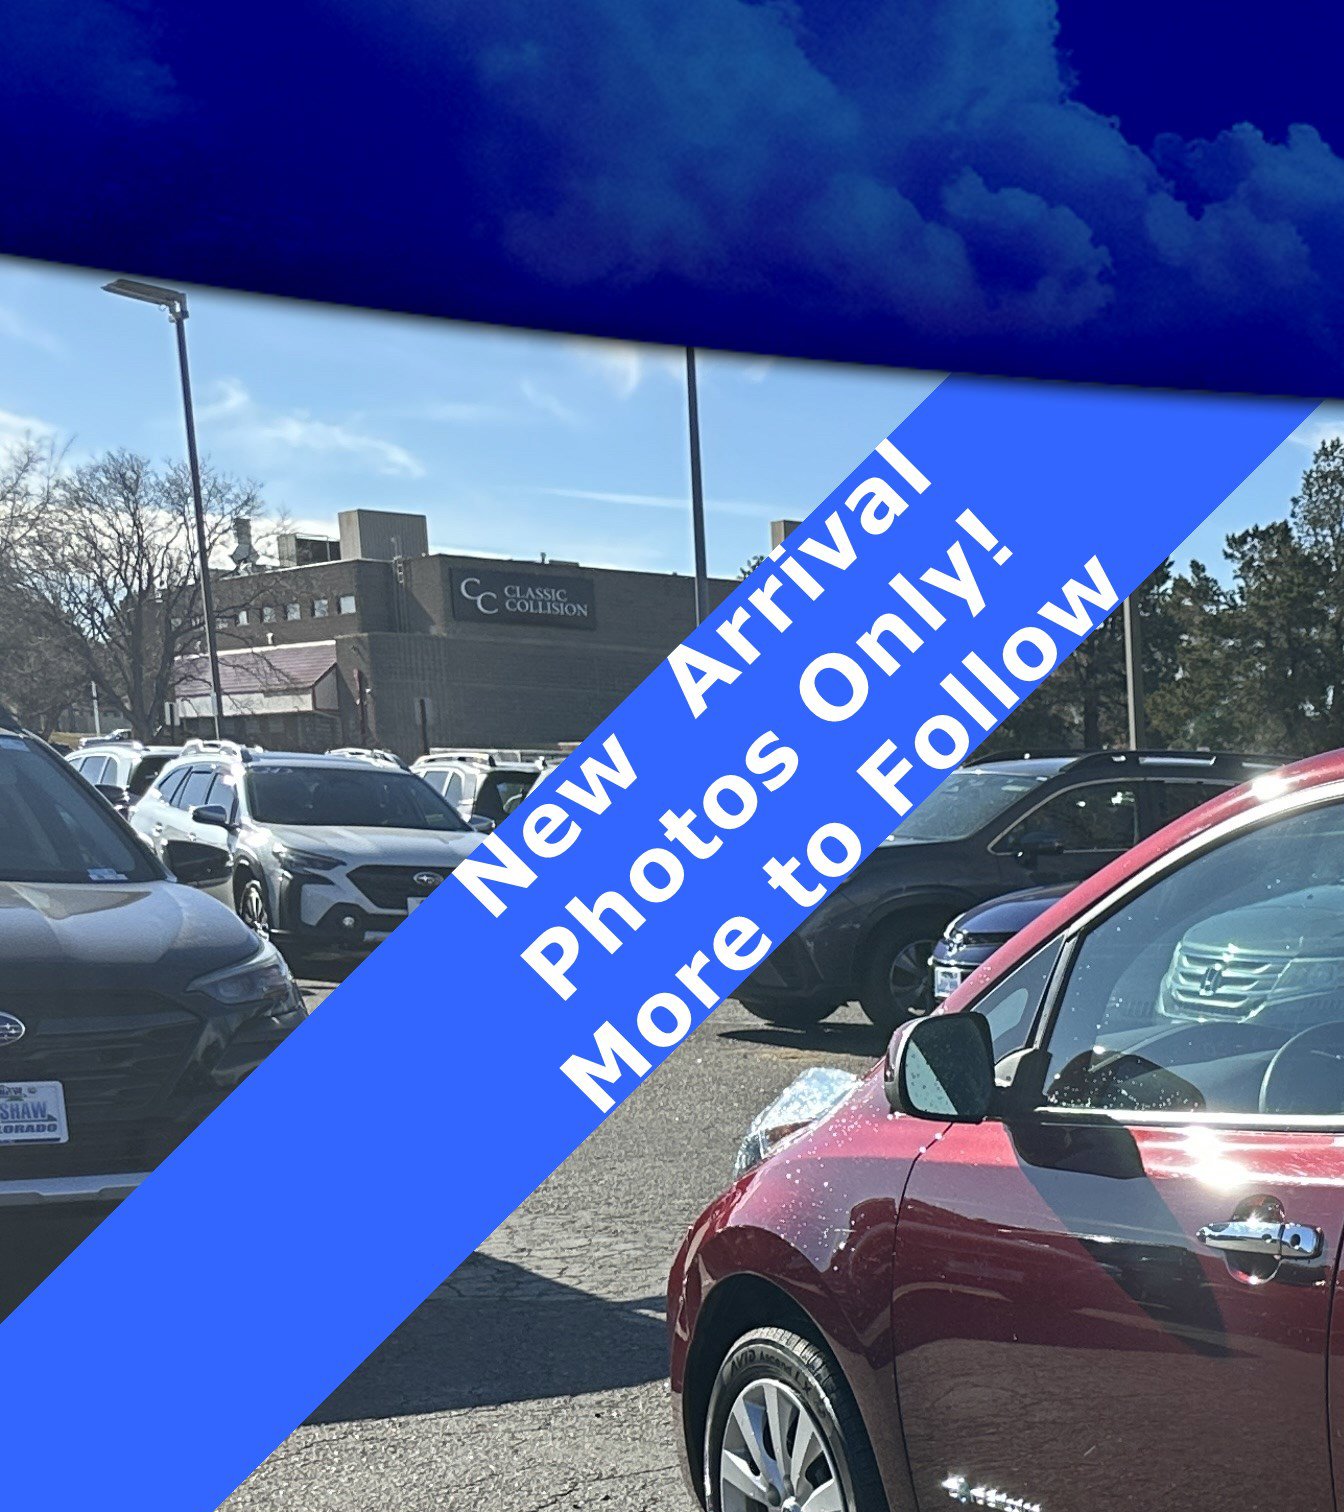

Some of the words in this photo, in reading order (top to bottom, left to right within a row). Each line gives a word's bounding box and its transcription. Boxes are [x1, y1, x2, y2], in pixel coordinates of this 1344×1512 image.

[504, 585, 568, 602] CLASSIC
[505, 598, 588, 617] COLLISION
[0, 1101, 47, 1120] SHAW
[0, 1123, 58, 1134] ORADO
